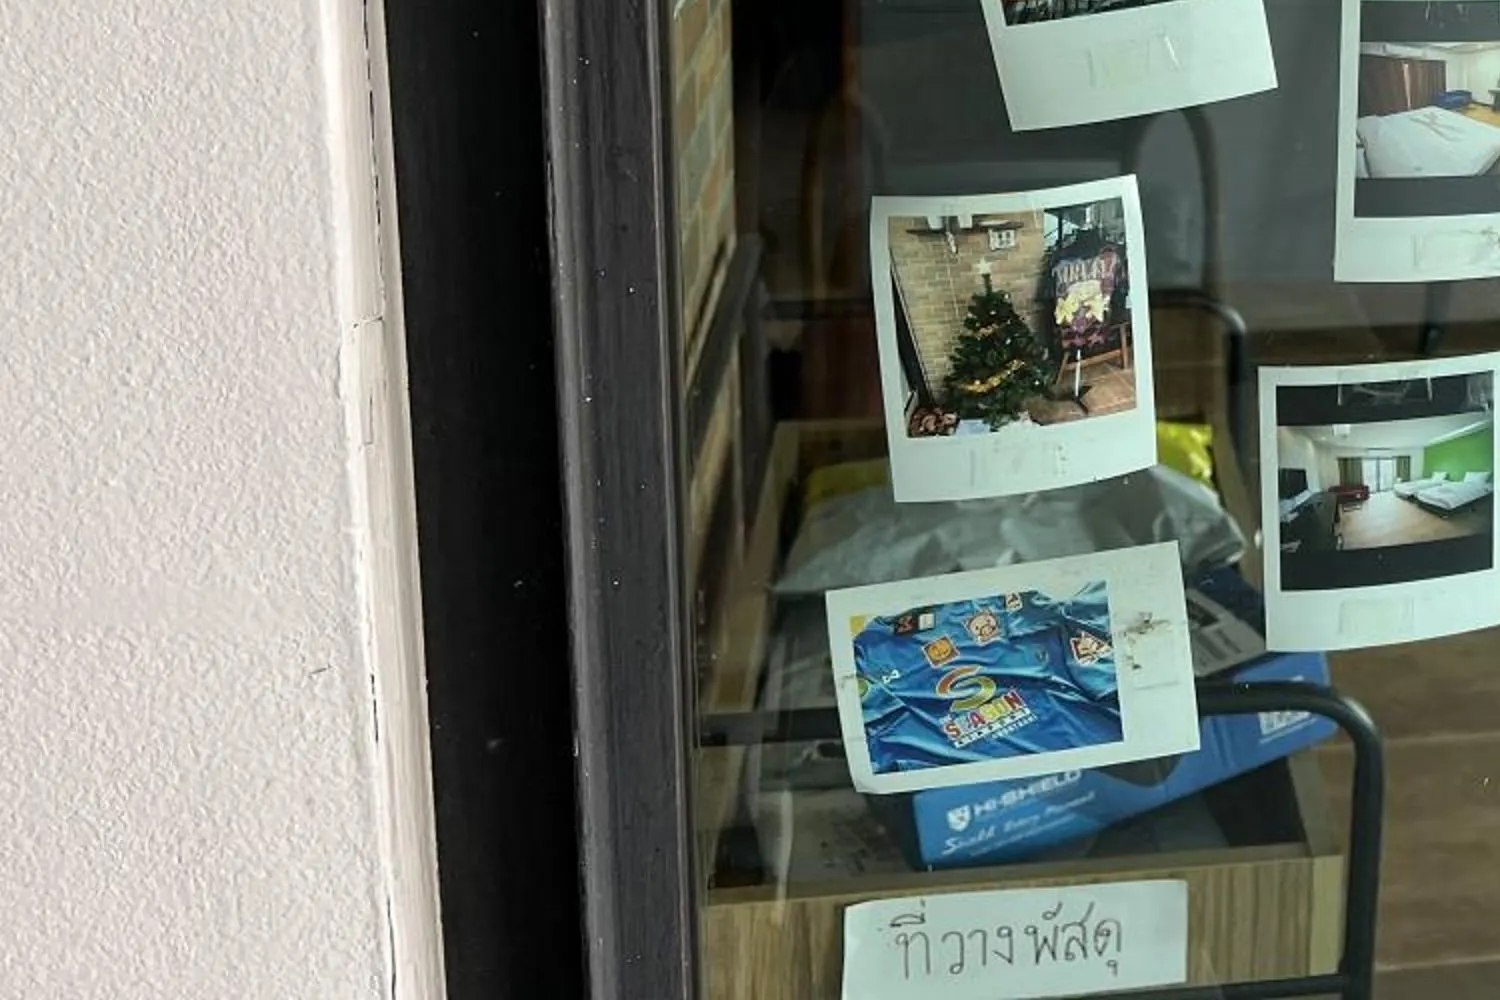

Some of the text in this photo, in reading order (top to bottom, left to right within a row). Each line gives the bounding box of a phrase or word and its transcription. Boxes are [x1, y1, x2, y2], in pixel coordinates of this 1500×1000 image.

[889, 899, 1122, 980] ที่วางพัสดุ
